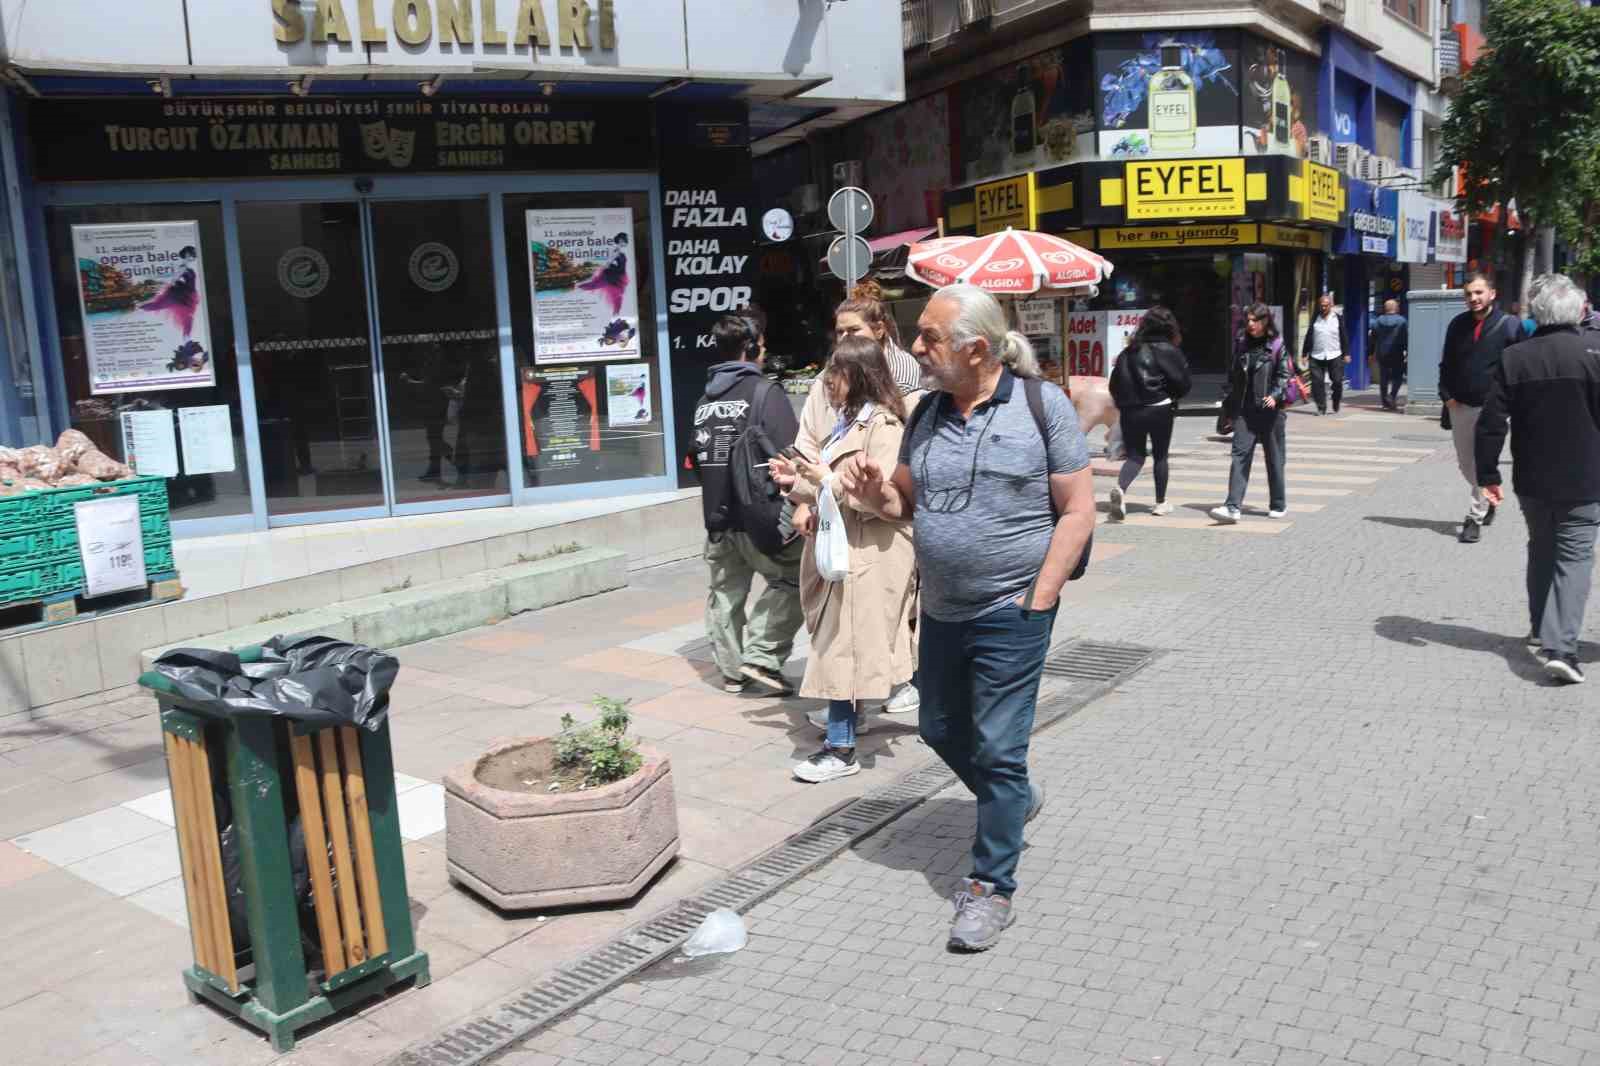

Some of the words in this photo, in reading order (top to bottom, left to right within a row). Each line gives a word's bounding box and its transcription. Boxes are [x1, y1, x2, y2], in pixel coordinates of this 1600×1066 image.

[272, 0, 616, 51] SALONLARI
[1155, 103, 1187, 116] EYFEL
[105, 125, 199, 151] TURGUT
[209, 117, 338, 149] ÖZAKMAN
[434, 117, 506, 146] ERGİN
[513, 121, 596, 145] ORBEY
[1137, 164, 1233, 196] EYFEL
[1312, 169, 1335, 201] EYFEL
[665, 189, 717, 206] DAHA
[979, 184, 1024, 216] EYFEL
[672, 207, 748, 228] FAZLA
[548, 238, 584, 249] opera
[587, 235, 615, 246] bale
[1116, 230, 1147, 242] her
[1150, 231, 1169, 240] an
[567, 248, 610, 259] günleri
[668, 239, 720, 255] DAHA
[101, 253, 144, 268] opera
[147, 248, 180, 262] bale
[675, 255, 749, 276] KOLAY
[124, 263, 175, 279] günleri
[920, 268, 949, 284] ALGIDA
[1055, 269, 1089, 281] ALGIDA
[979, 277, 1024, 289] ALGIDA
[670, 286, 752, 313] SPOR
[1068, 315, 1097, 335] Adet
[673, 336, 686, 349] 1.
[696, 334, 718, 348] KA
